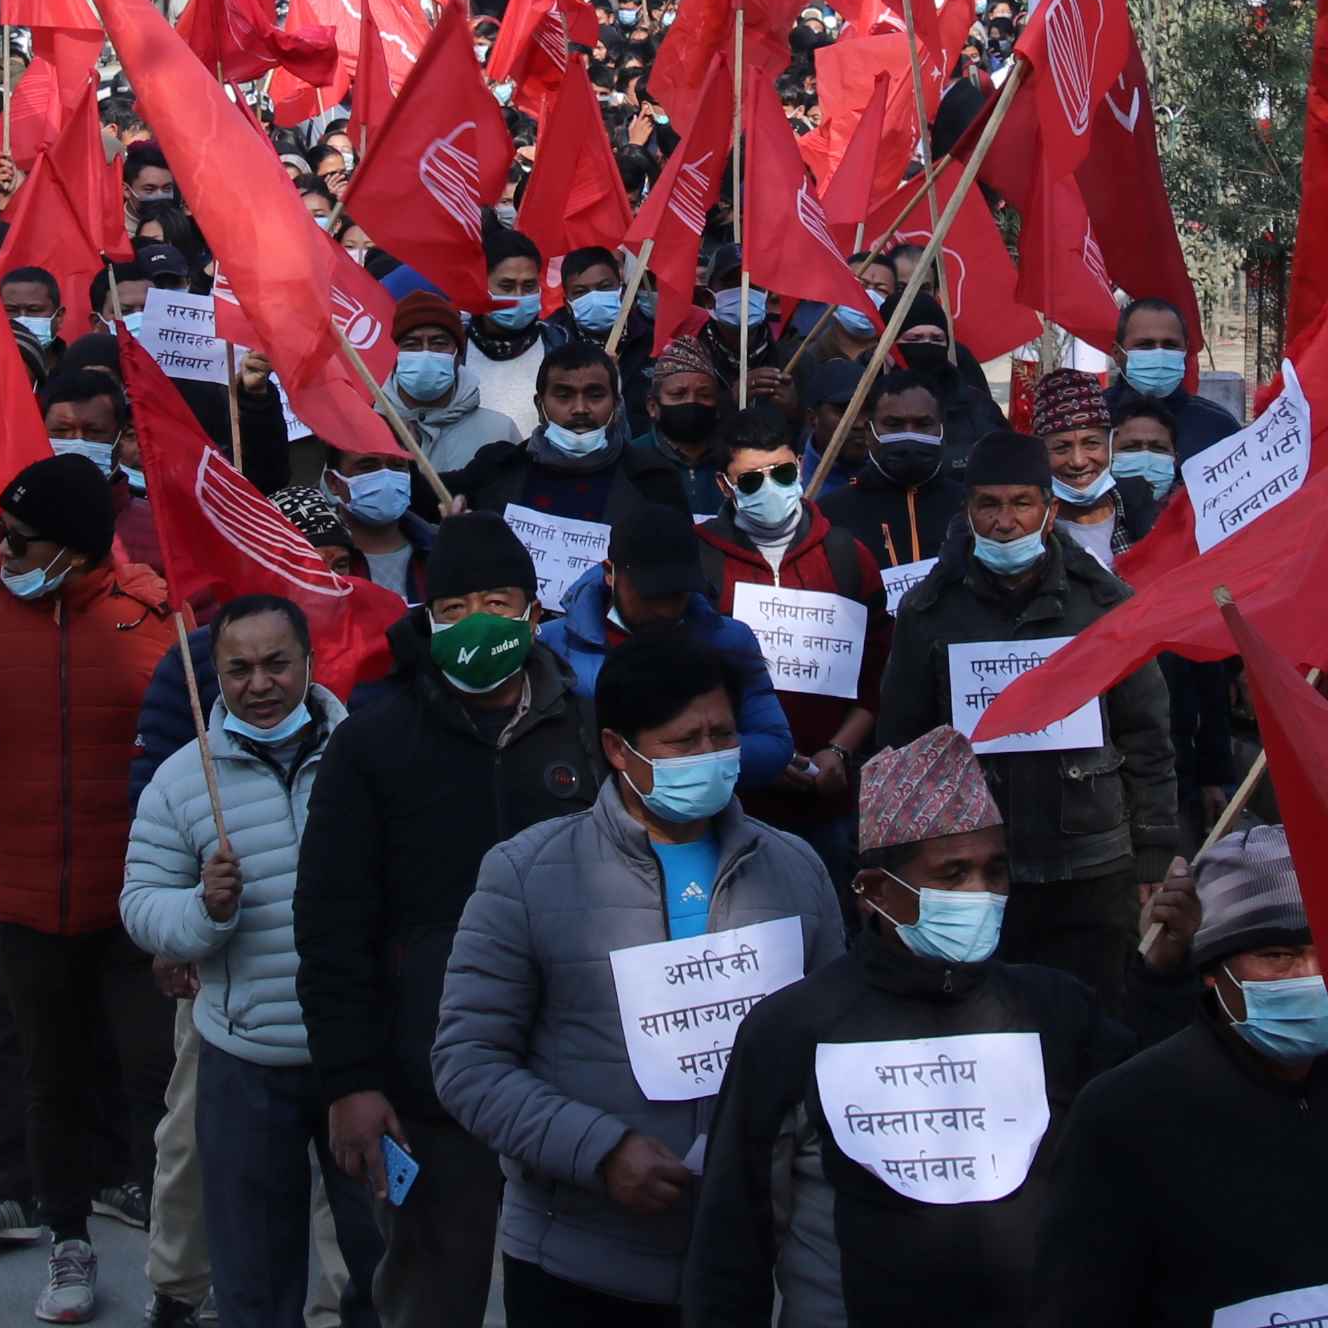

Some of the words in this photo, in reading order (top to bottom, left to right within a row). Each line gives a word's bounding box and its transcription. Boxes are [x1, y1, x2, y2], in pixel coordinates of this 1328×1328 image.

[490, 637, 520, 657] audan
[663, 943, 761, 986] अमेरिकी
[639, 992, 768, 1038] साम्राज्यवा
[875, 1054, 978, 1088] भारतीय
[844, 1104, 986, 1135] विस्तारवाद
